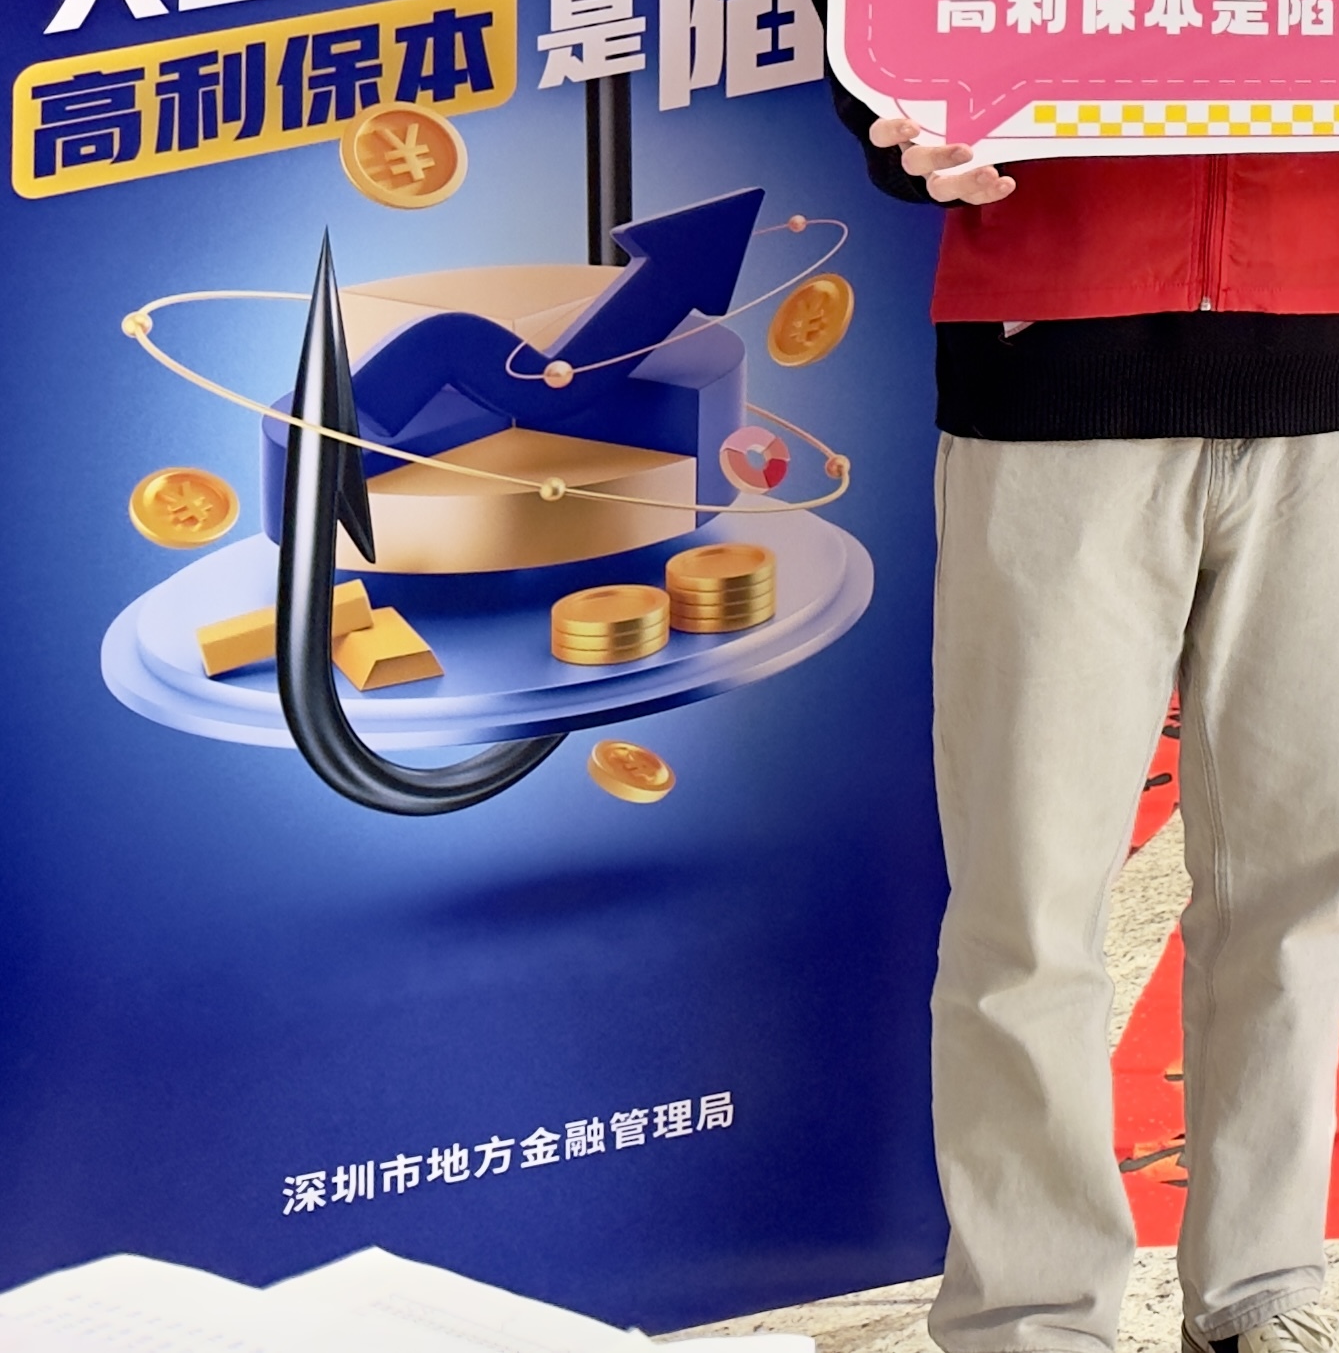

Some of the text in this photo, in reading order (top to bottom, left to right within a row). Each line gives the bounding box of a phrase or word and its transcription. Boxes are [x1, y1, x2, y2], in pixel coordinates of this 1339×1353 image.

[30, 9, 494, 180] 高利保本
[281, 1090, 736, 1217] 深圳市地方金融管理局
